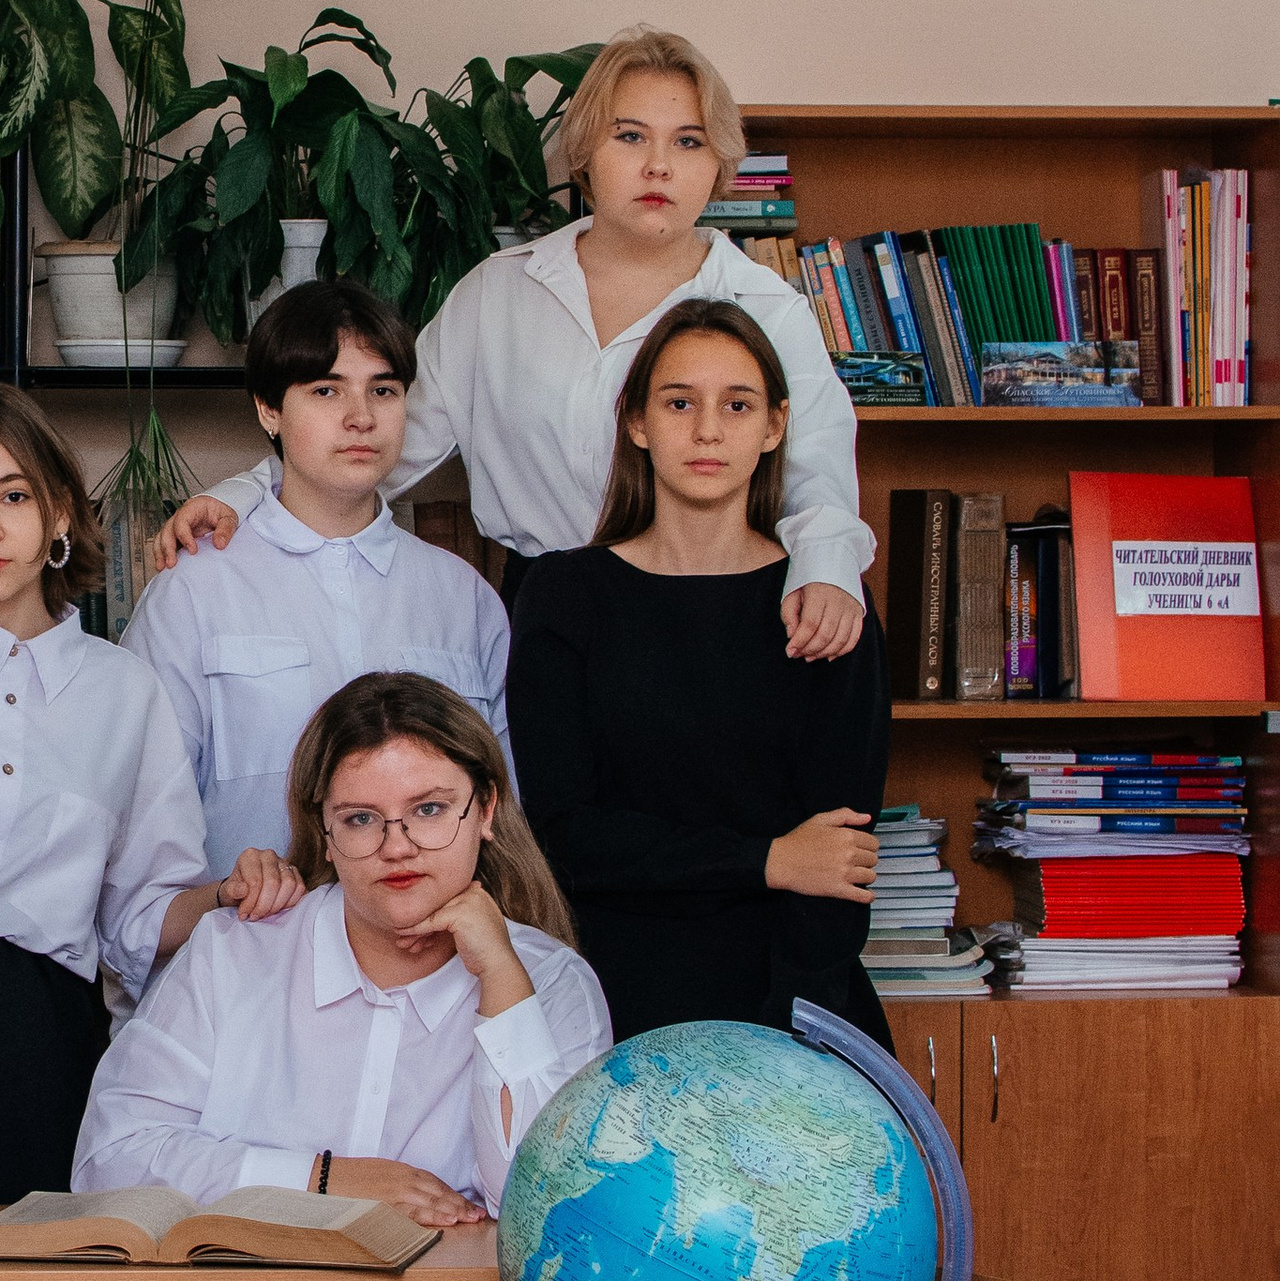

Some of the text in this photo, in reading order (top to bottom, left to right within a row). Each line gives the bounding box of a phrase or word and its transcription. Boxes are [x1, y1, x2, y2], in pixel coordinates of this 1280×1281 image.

[855, 269, 874, 322] СТРАНИЦЫ
[928, 501, 943, 666] СЛОВАРЬ ИНОСТРАННЫХ СЛОВ
[1115, 547, 1252, 567] ЧИТАТЕЛЬСКИЙ ДНЕВНИК
[1133, 569, 1240, 589] ГОЛОУХОВОЙ ДАРЬИ
[1010, 544, 1019, 676] СЛОВООБРАЗОВАТЕЛЬНЫЙ СЛОВАРЬ
[1022, 580, 1030, 643] РУССКОГО ЯЗЫКА
[1148, 594, 1202, 610] УЧЕНИЦЫ
[1207, 595, 1213, 609] 6
